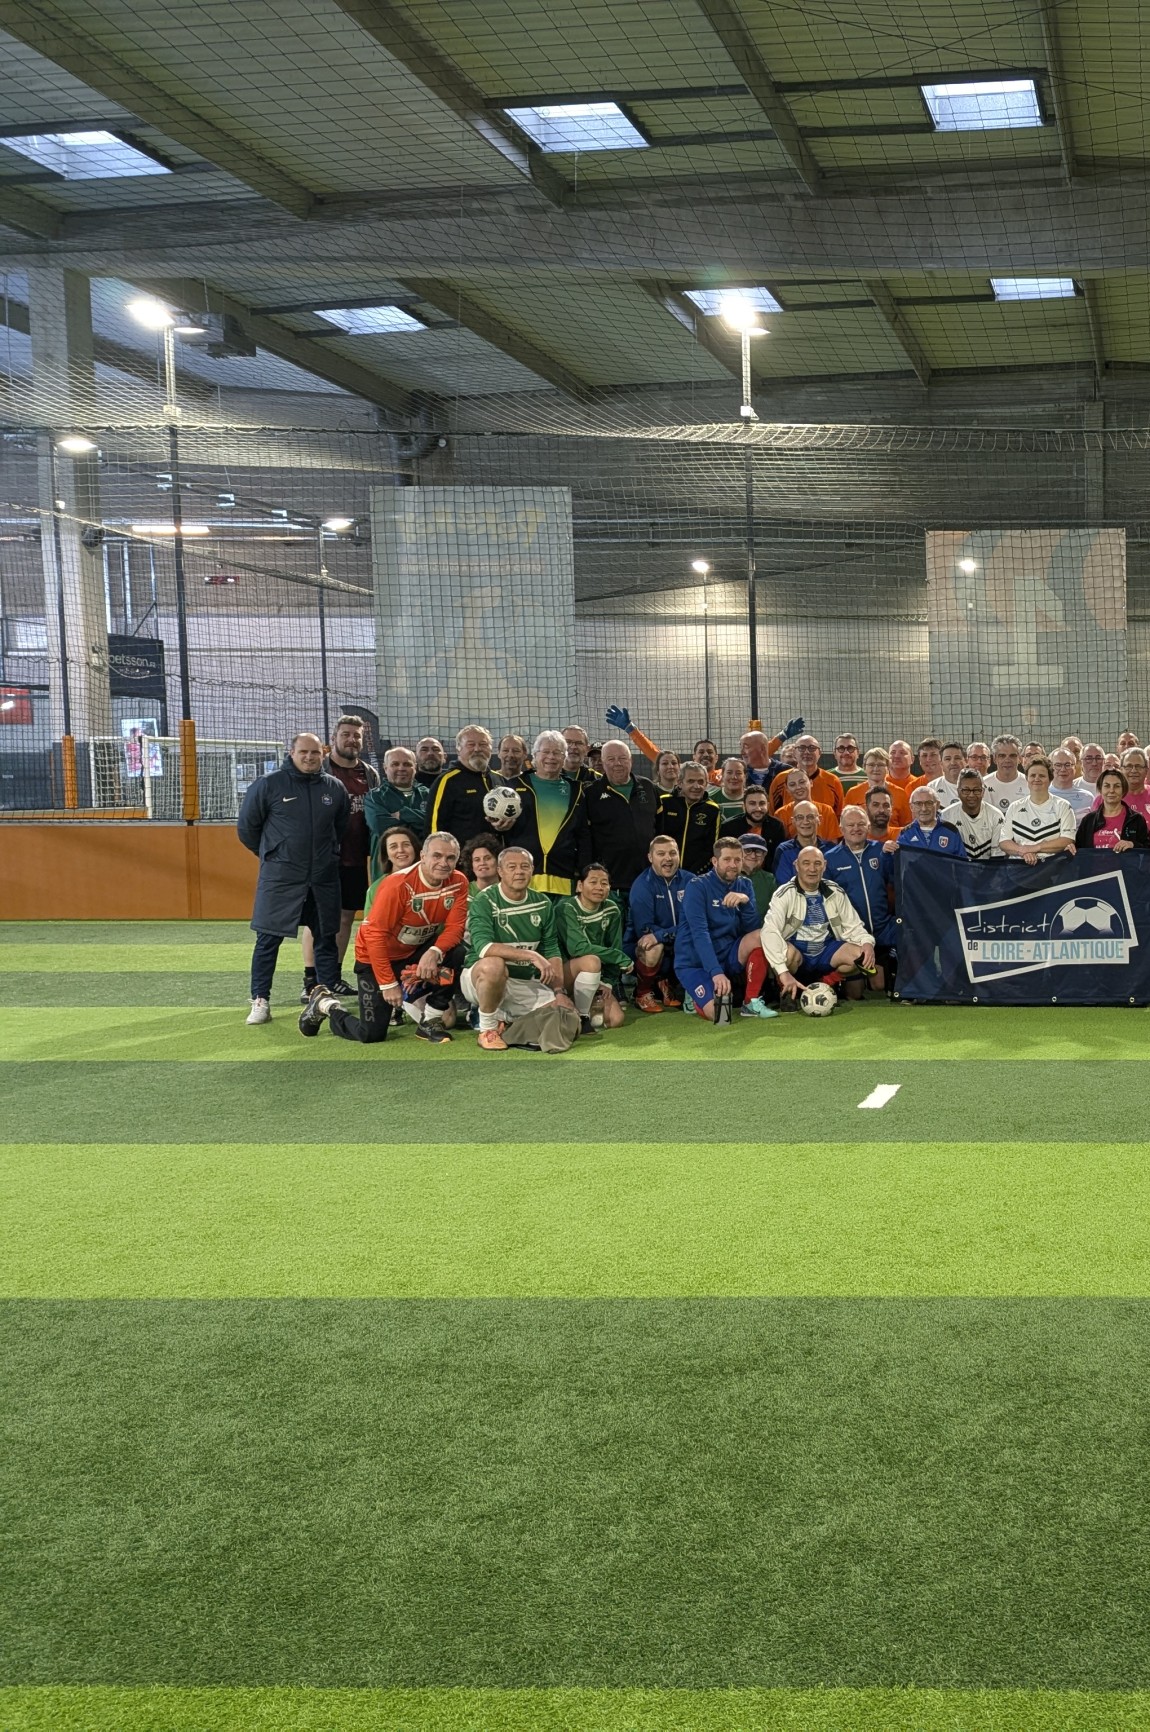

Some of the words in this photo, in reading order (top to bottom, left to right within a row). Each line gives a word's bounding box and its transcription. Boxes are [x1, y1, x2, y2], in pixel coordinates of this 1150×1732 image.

[967, 910, 1050, 933] district
[967, 940, 978, 950] de
[362, 993, 375, 1022] asics
